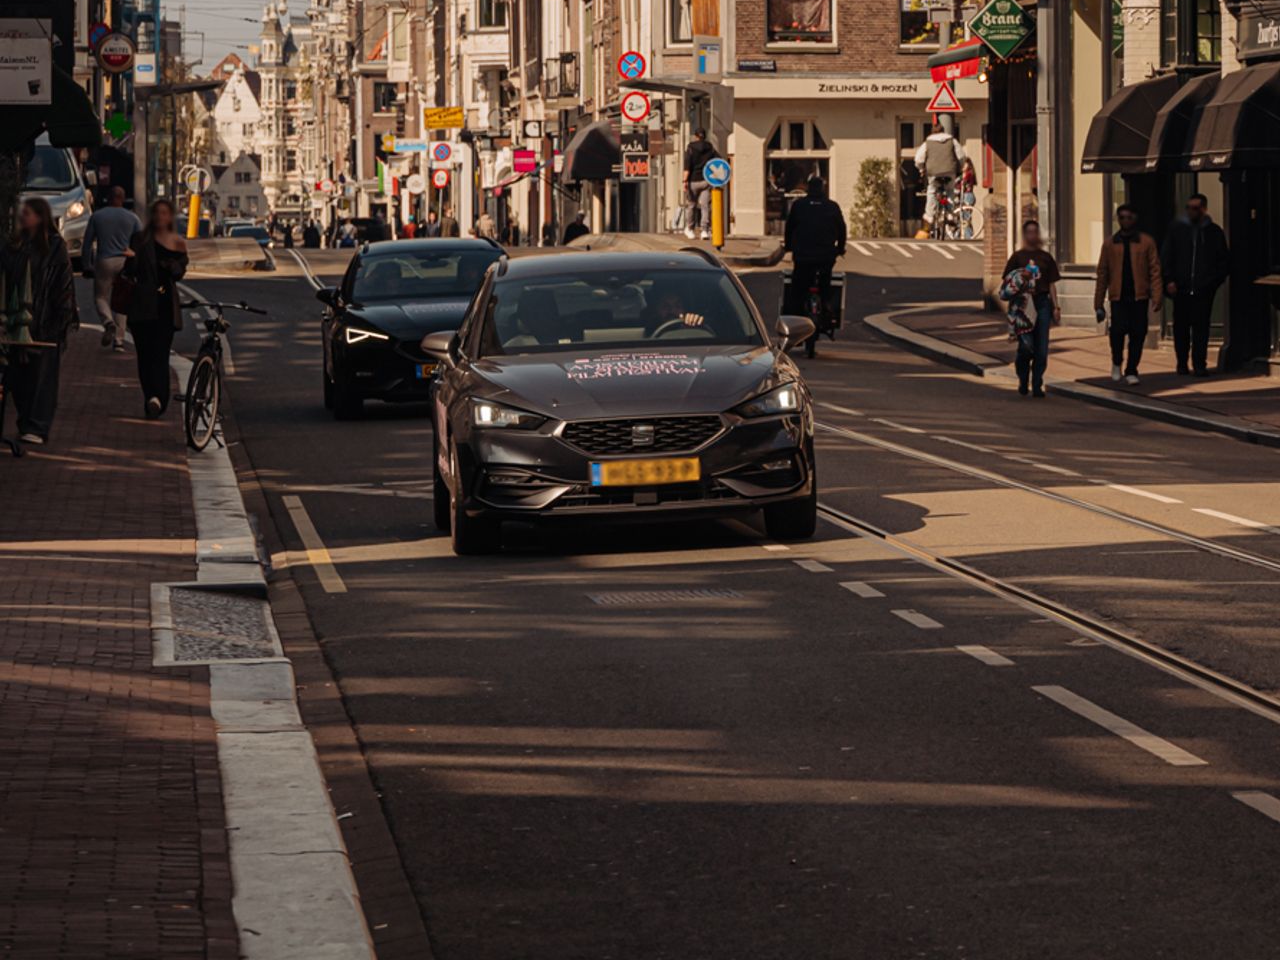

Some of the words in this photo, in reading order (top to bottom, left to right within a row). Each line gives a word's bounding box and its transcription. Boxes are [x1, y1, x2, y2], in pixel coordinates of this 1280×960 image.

[818, 83, 868, 93] ZIELINSKI
[870, 83, 879, 93] &
[881, 84, 918, 93] ROZEN
